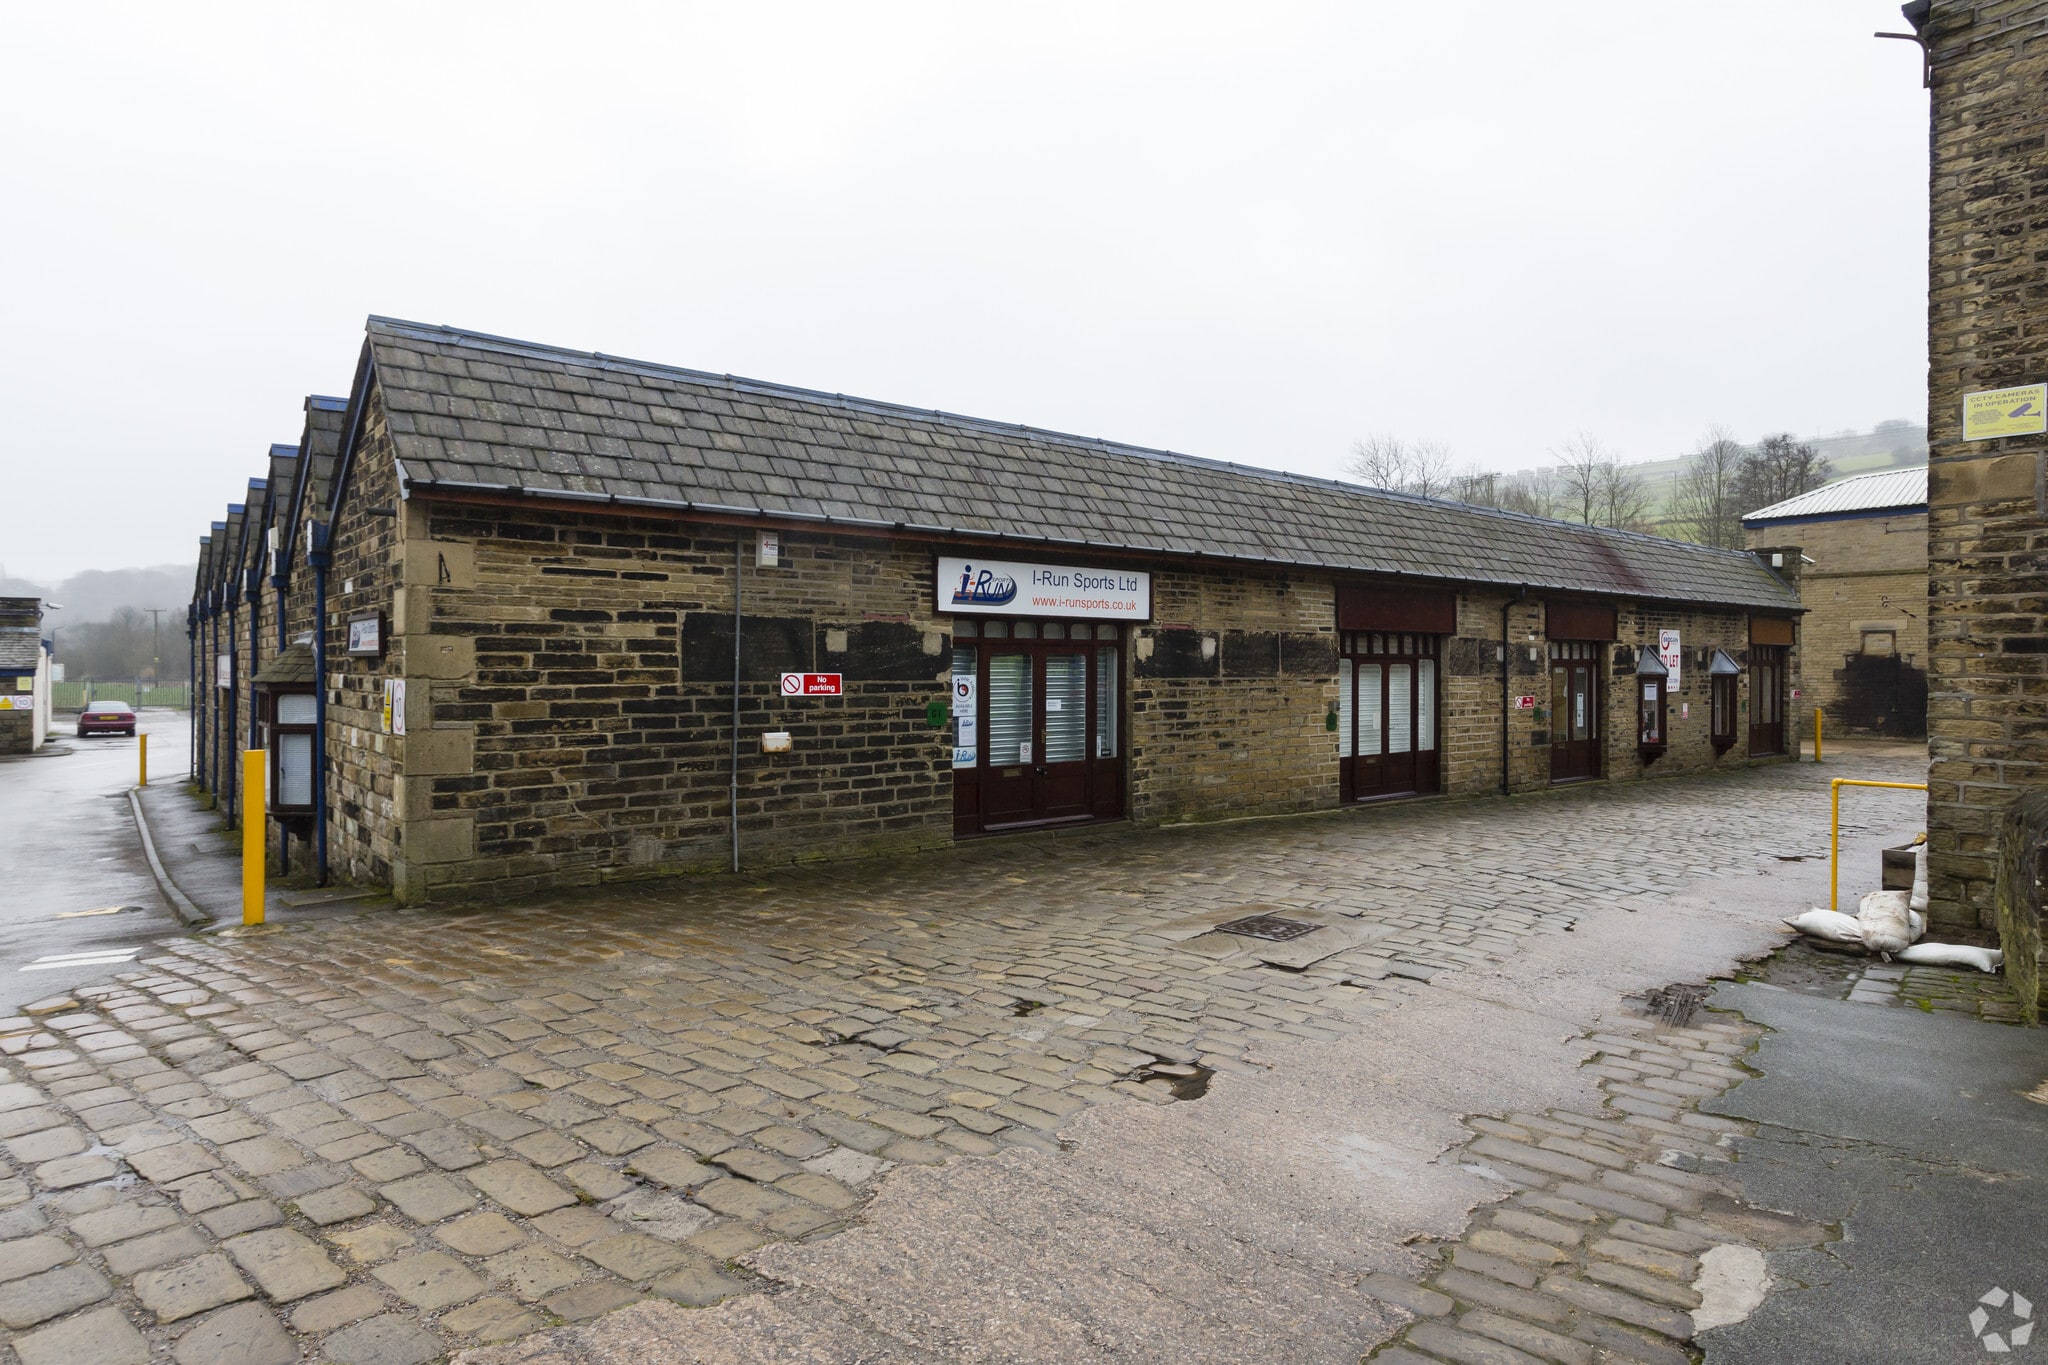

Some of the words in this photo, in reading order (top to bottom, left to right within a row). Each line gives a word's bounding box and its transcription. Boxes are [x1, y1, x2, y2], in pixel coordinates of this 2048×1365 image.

[1970, 395, 1993, 403] CCTV
[1995, 388, 2041, 399] CAMERAS
[1985, 396, 2036, 407] OPERATION
[991, 576, 1012, 584] SPORTS
[1032, 569, 1069, 587] I-Run
[1073, 572, 1115, 592] Sports
[1118, 576, 1138, 592] Ltd
[1031, 595, 1137, 611] www.i-runsports.co.uk
[1661, 654, 1668, 667] TO
[1669, 654, 1679, 668] LET
[816, 675, 827, 683] No
[809, 684, 836, 693] parking
